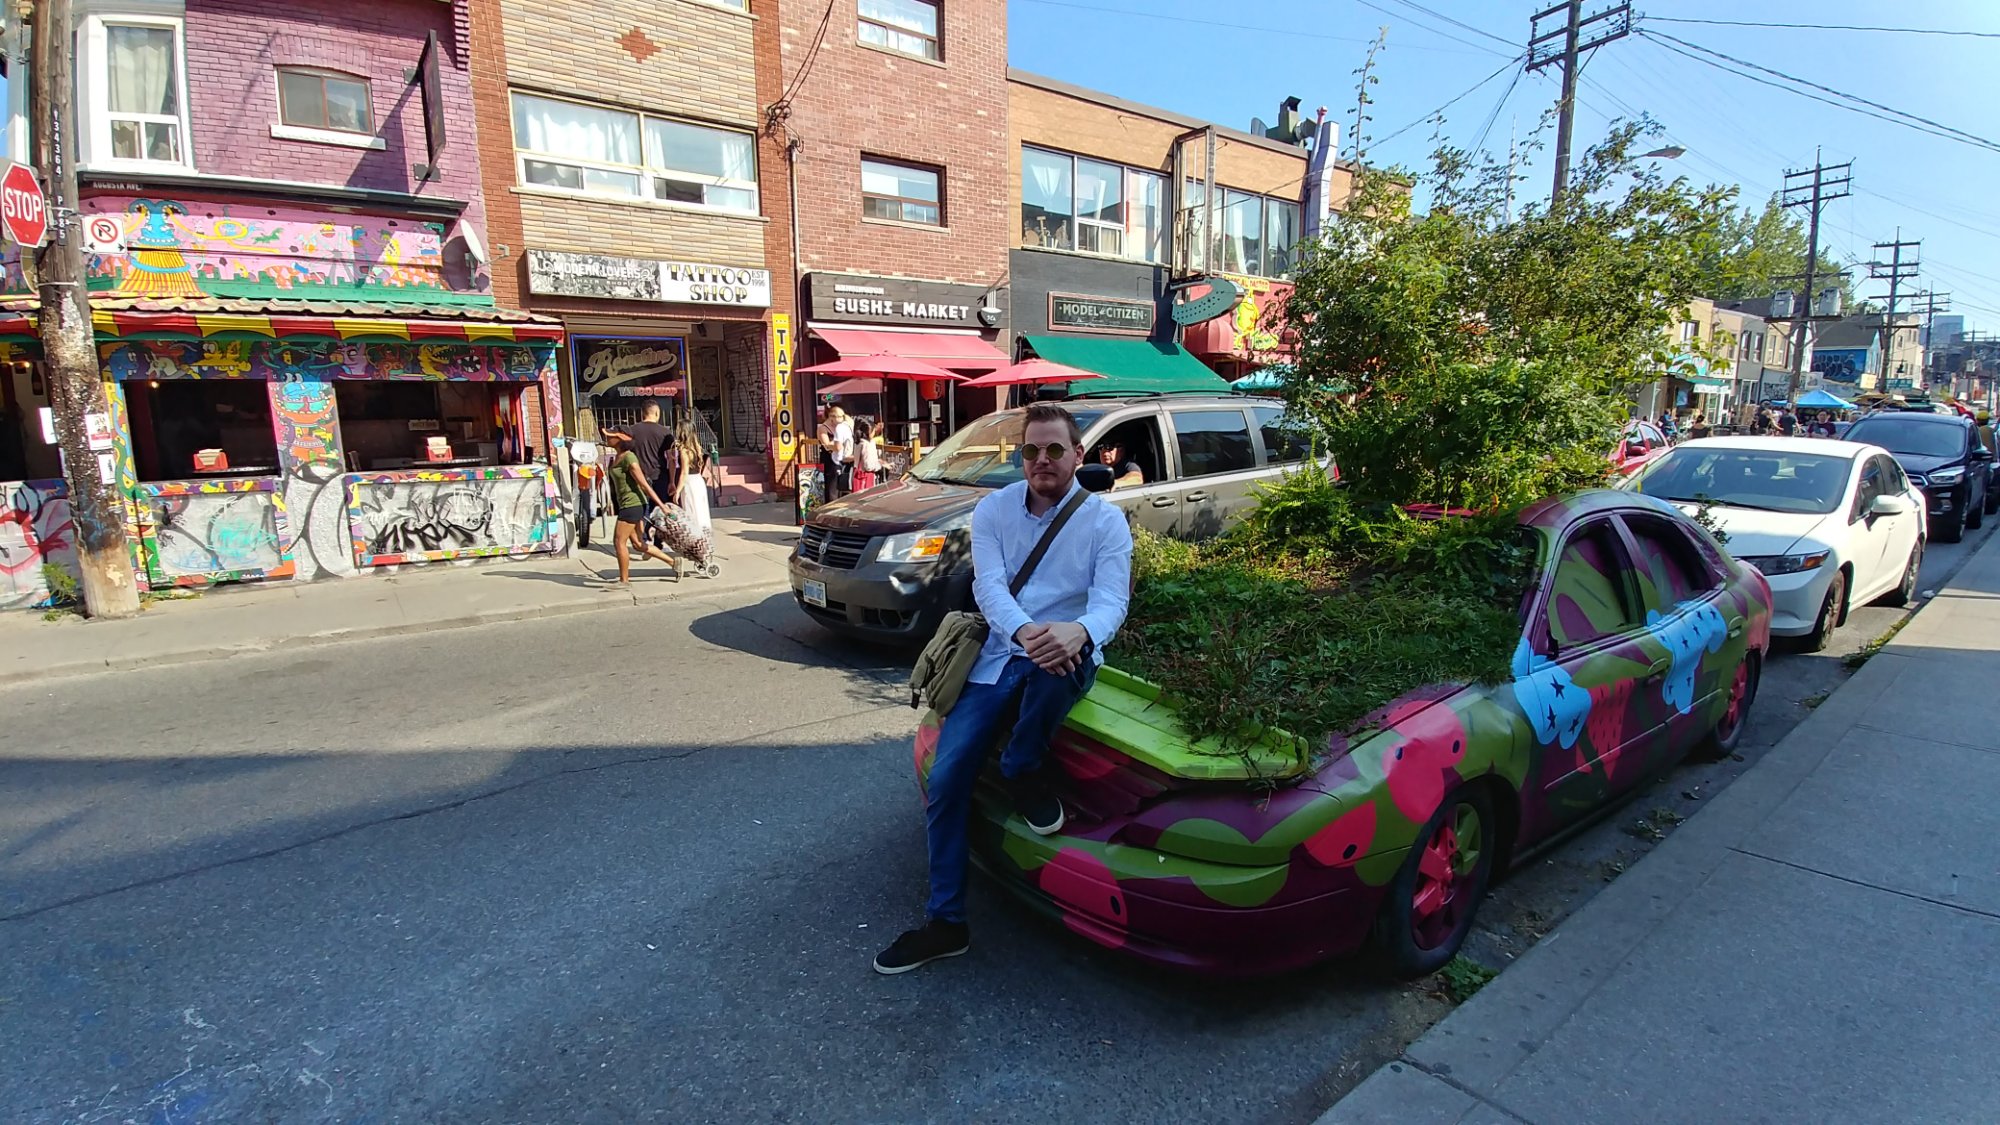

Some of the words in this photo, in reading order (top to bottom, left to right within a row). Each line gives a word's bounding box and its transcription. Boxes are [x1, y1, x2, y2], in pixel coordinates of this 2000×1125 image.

[4, 187, 42, 223] STOP
[554, 261, 600, 277] MODERN
[600, 263, 640, 279] LOVERS
[666, 263, 752, 286] TATTOO
[751, 270, 765, 279] EST
[689, 283, 748, 303] SHOP
[834, 297, 893, 315] SUSHI
[902, 302, 970, 319] MARKET
[1062, 303, 1099, 317] MODEL
[1106, 307, 1144, 320] CITIZEN
[617, 386, 653, 397] TATTOO
[776, 329, 792, 445] TATTOO
